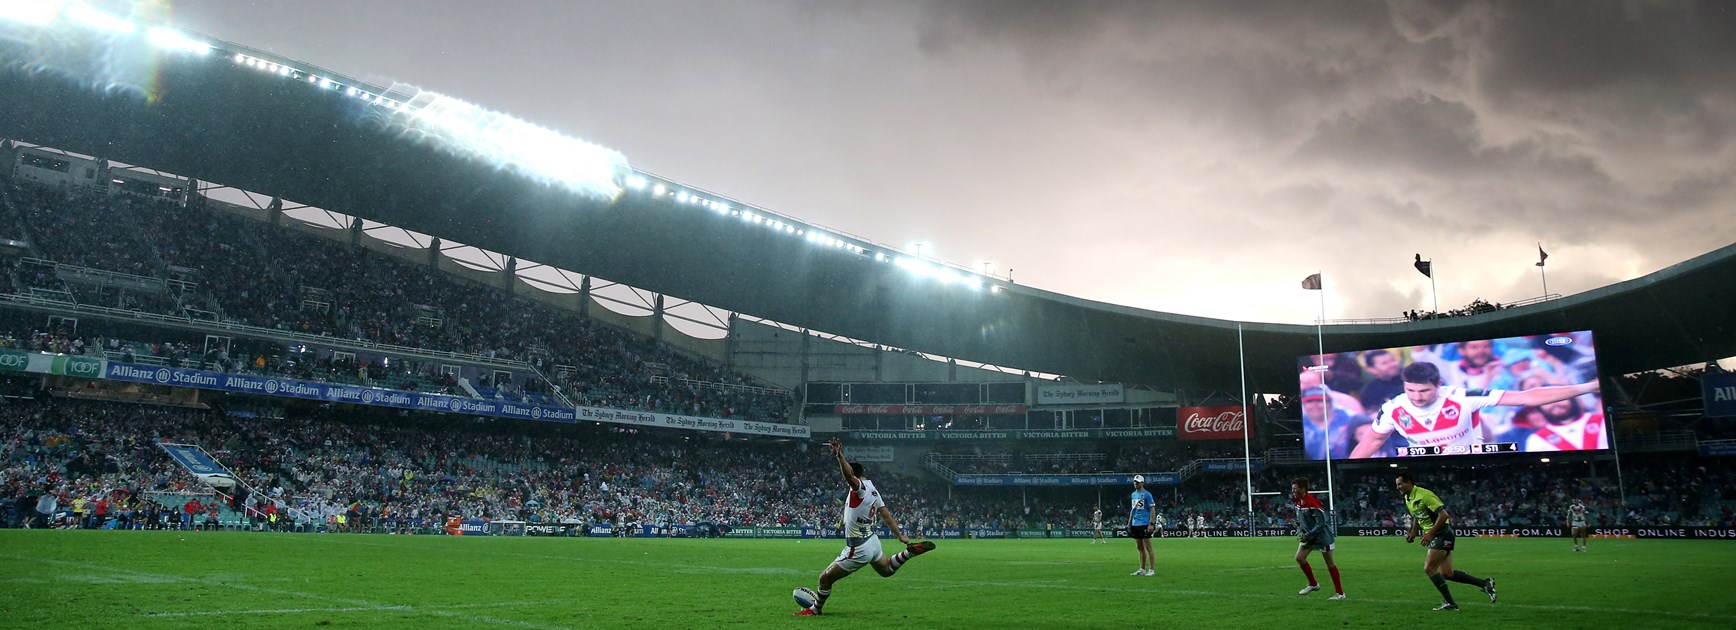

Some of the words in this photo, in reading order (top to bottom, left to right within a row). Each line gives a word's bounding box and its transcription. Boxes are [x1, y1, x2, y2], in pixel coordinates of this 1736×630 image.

[71, 361, 99, 374] IOOF
[111, 365, 154, 379] Allianz
[172, 371, 217, 385] Stadium
[225, 377, 263, 390] Allianz
[279, 382, 319, 395] Stadium
[327, 388, 360, 400] Allianz
[375, 392, 411, 405] Stadium
[417, 397, 449, 408] Allianz
[462, 401, 496, 412] Stadium
[502, 405, 530, 416] Allianz
[543, 409, 573, 419] Stadium
[1184, 411, 1245, 433] Coca-Cola
[1409, 448, 1426, 456] SYD
[1433, 446, 1441, 454] 0
[1510, 443, 1516, 451] 4
[1638, 529, 1686, 537] ONLINE
